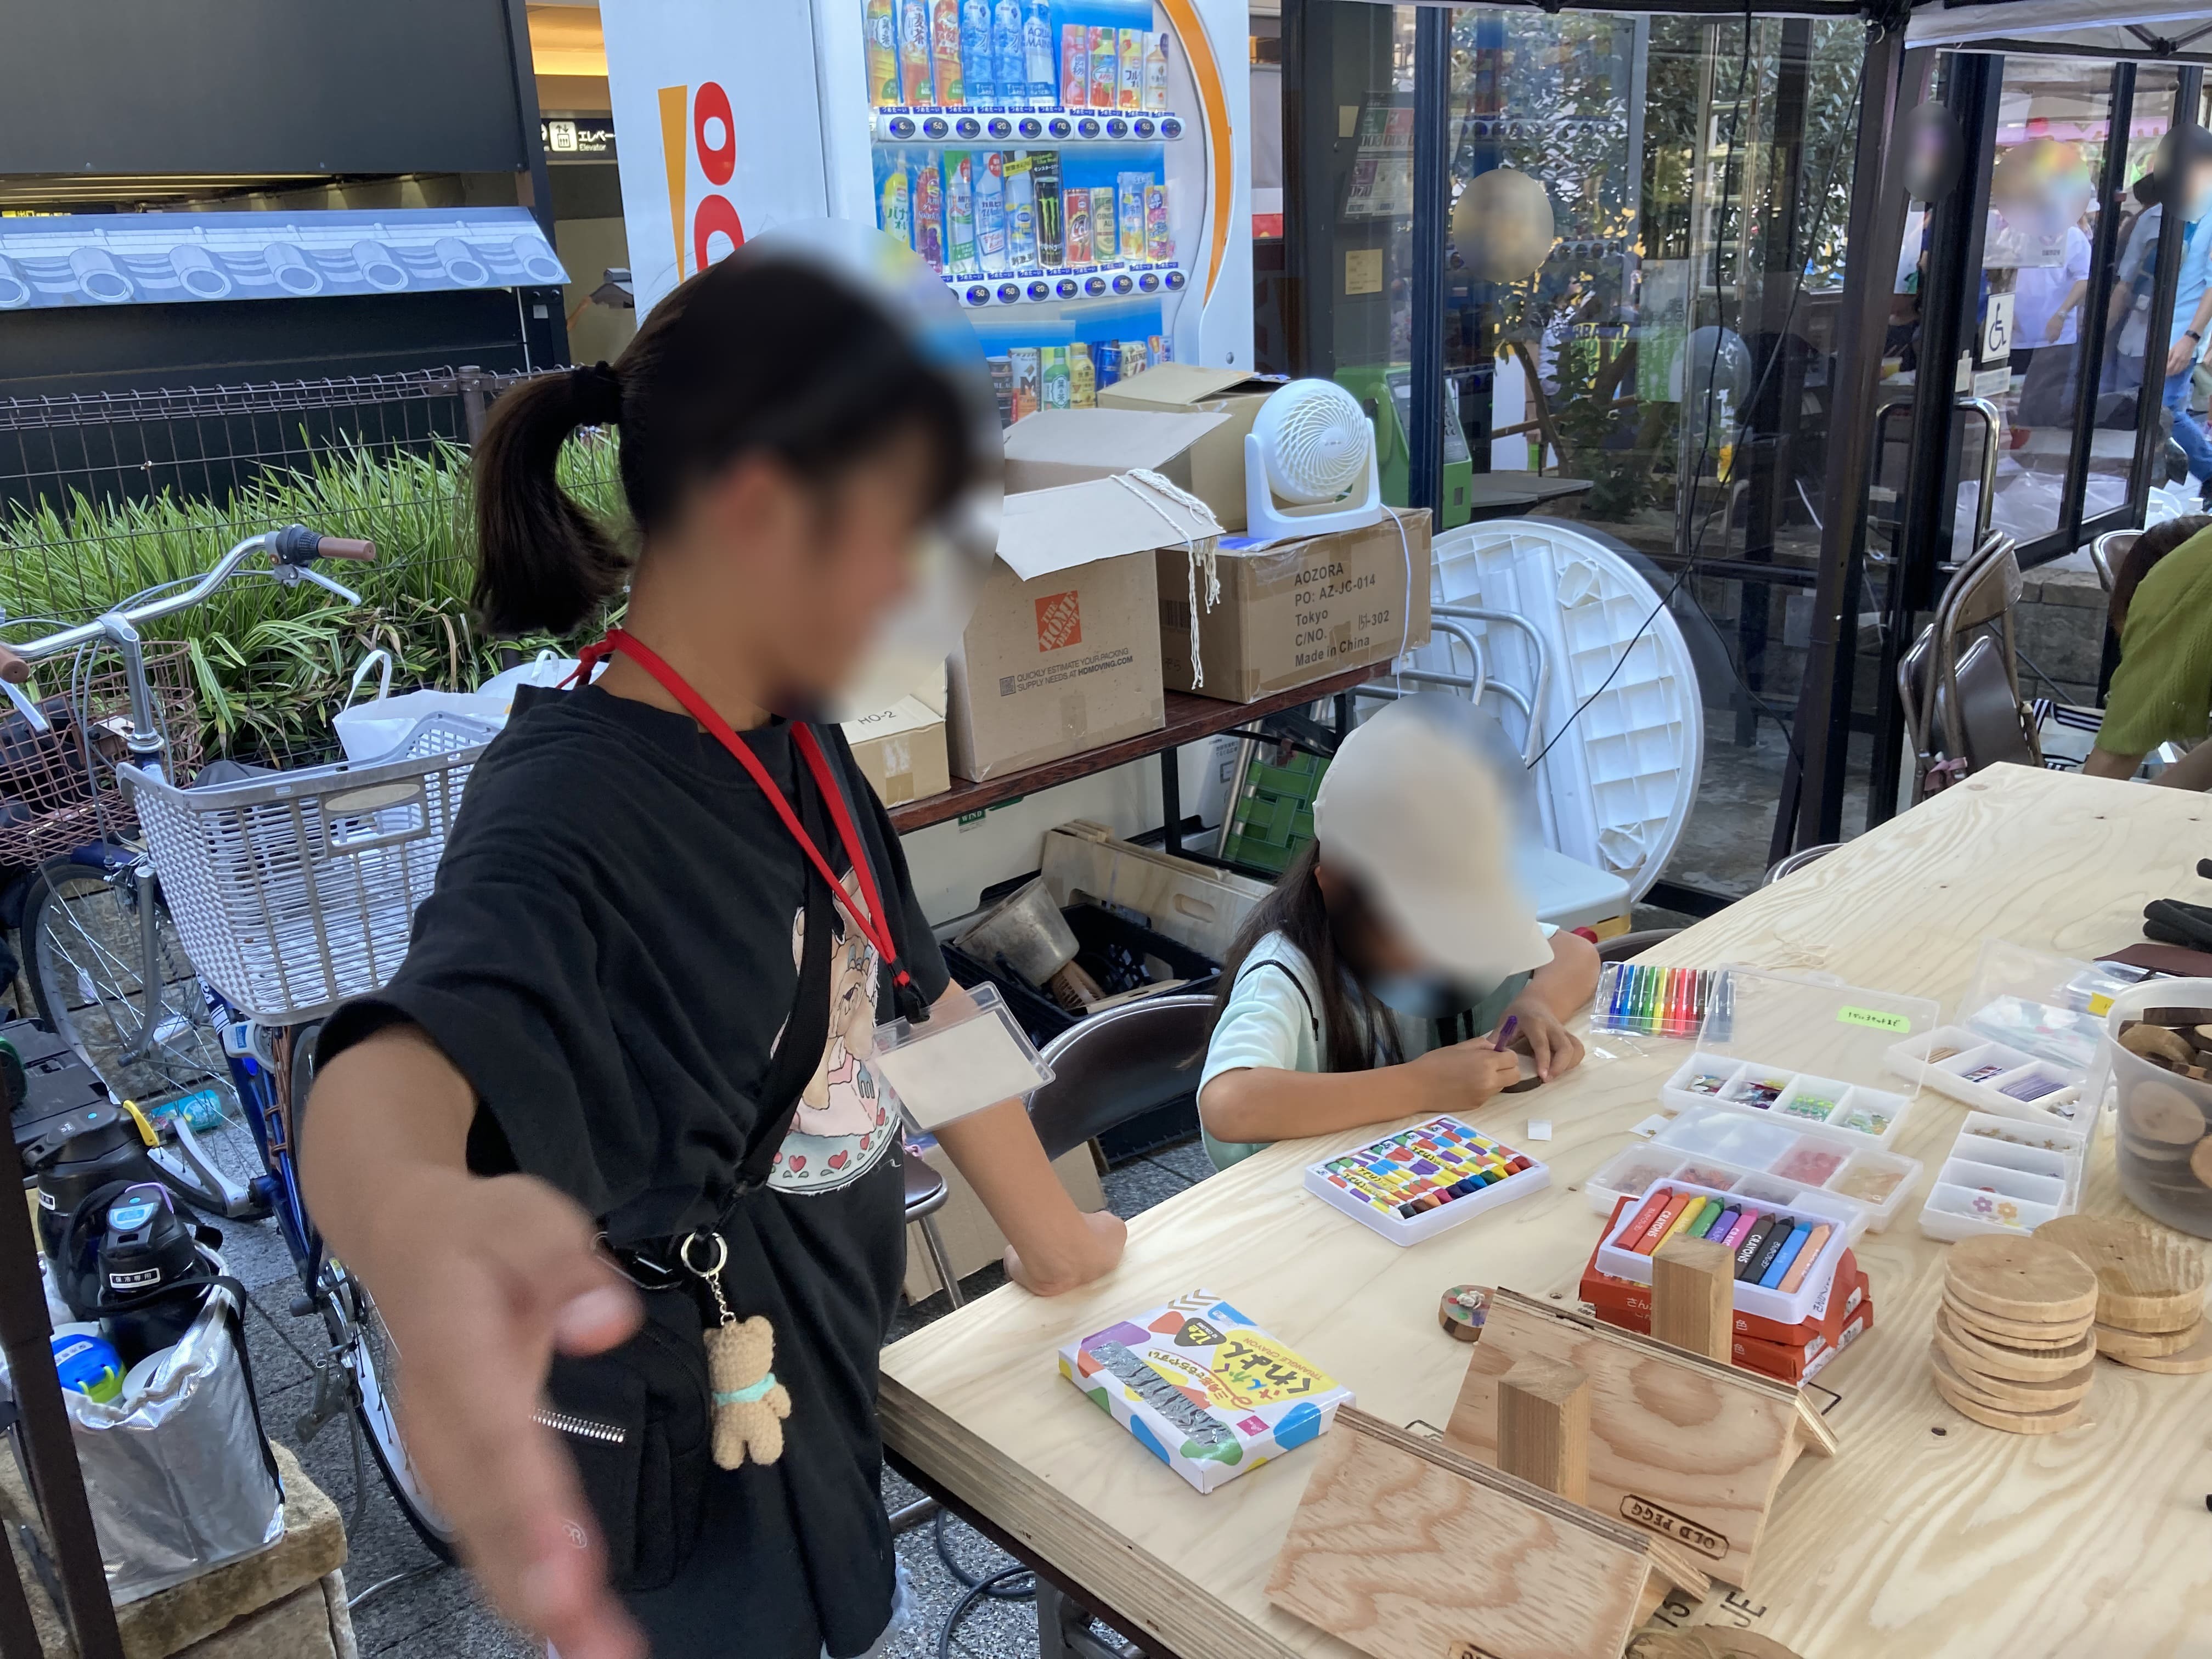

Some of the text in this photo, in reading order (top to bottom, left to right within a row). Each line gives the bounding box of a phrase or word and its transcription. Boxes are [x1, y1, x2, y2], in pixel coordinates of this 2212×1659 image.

[579, 143, 606, 151] Elevator
[1294, 562, 1344, 586] AOZORA
[1295, 574, 1375, 606] PO: AZ-JC-014
[1040, 592, 1079, 650] HOME
[1041, 601, 1058, 624] THE
[1056, 610, 1079, 647] DEPOT
[1295, 610, 1328, 627] Tokyo
[1295, 628, 1328, 646] C/NO.
[1295, 636, 1370, 667] Made in China
[1017, 647, 1128, 682] QUICKLY ESTIMATE YOUR PACKING
[1018, 656, 1133, 691] SUPPLY NEEDS AT HDMOVING.COM
[1647, 1210, 1672, 1238] CRAYONS
[1737, 1234, 1762, 1263] CRAYONS
[1626, 1297, 1651, 1311] さん
[1222, 1341, 1311, 1394] くれよん
[1243, 1338, 1323, 1380] TRIANGLE CRAYON
[1148, 1351, 1228, 1400] 三角形でもちやすい
[1214, 1363, 1280, 1400] さんかく
[1630, 1502, 1716, 1549] OLD PEGG
